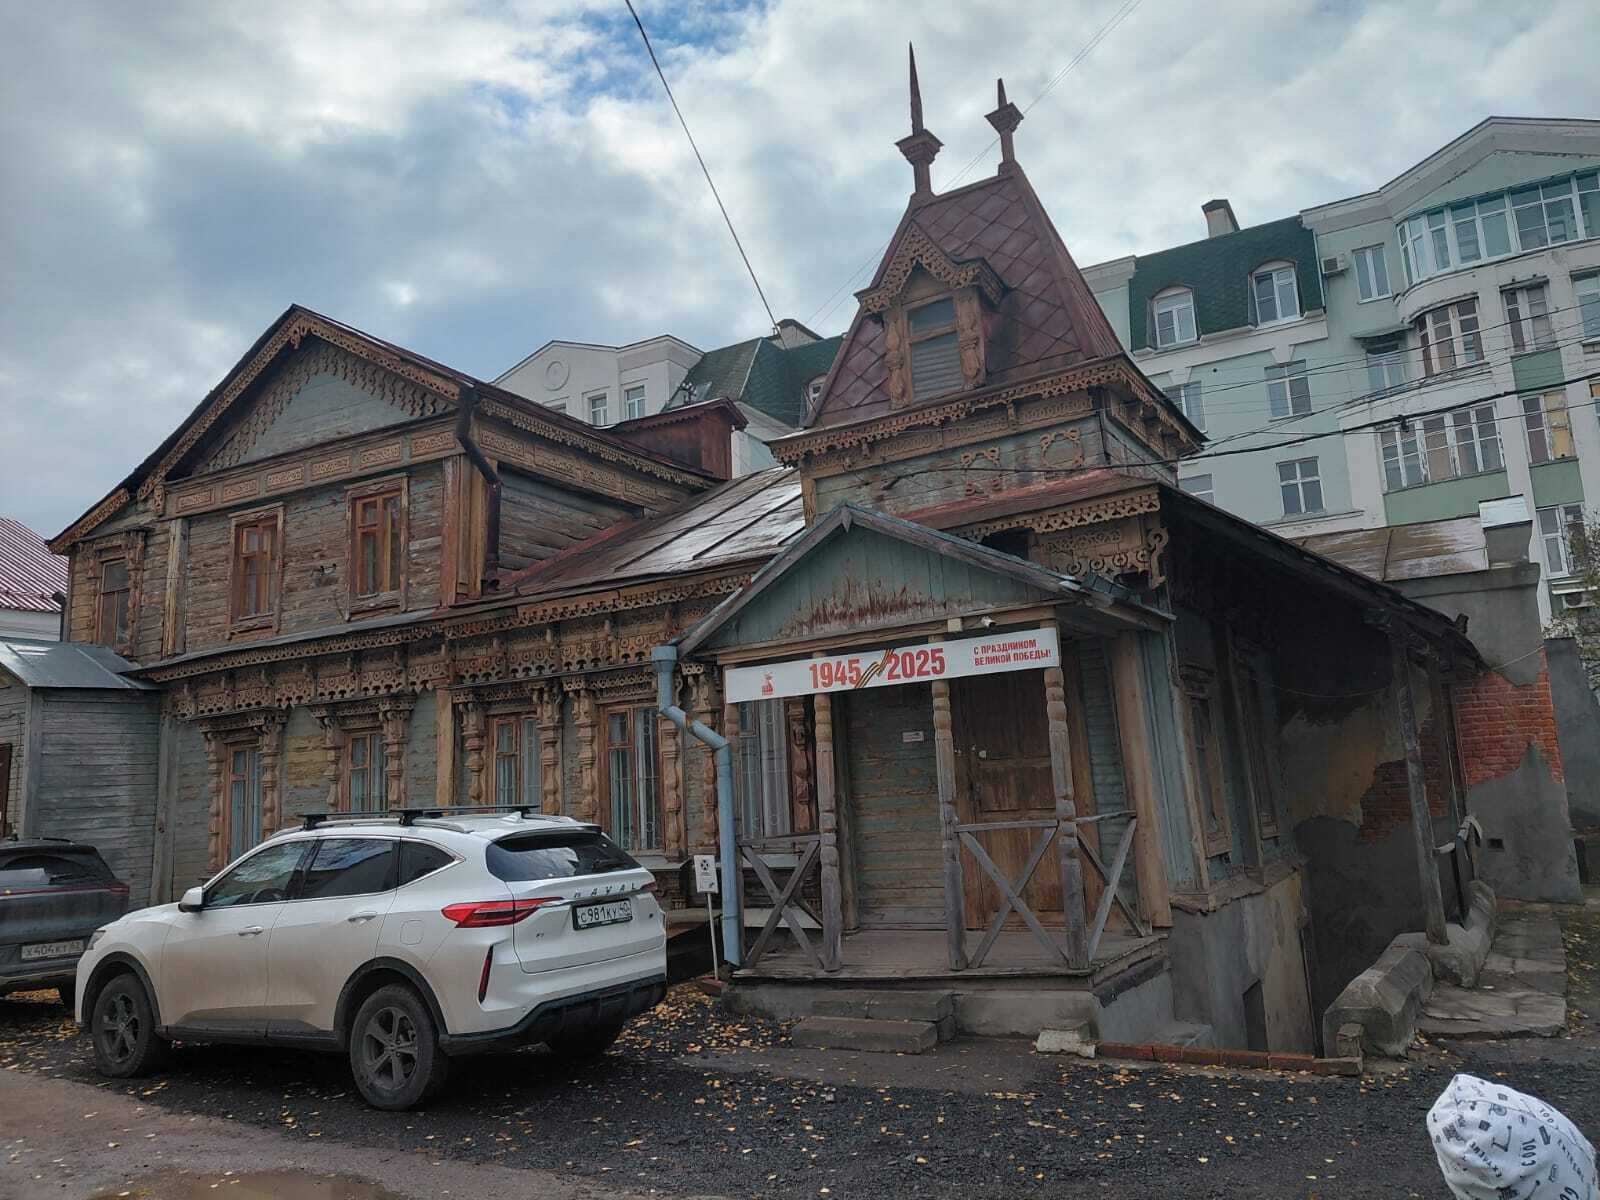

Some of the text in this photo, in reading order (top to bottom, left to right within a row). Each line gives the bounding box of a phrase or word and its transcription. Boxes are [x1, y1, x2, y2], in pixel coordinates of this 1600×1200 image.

[973, 639, 1037, 655] С ПРАЗДНИКОМ
[974, 649, 1052, 666] ВЕЛИКОЙ ПОБЕДЫ!
[809, 648, 946, 689] 1945 2025
